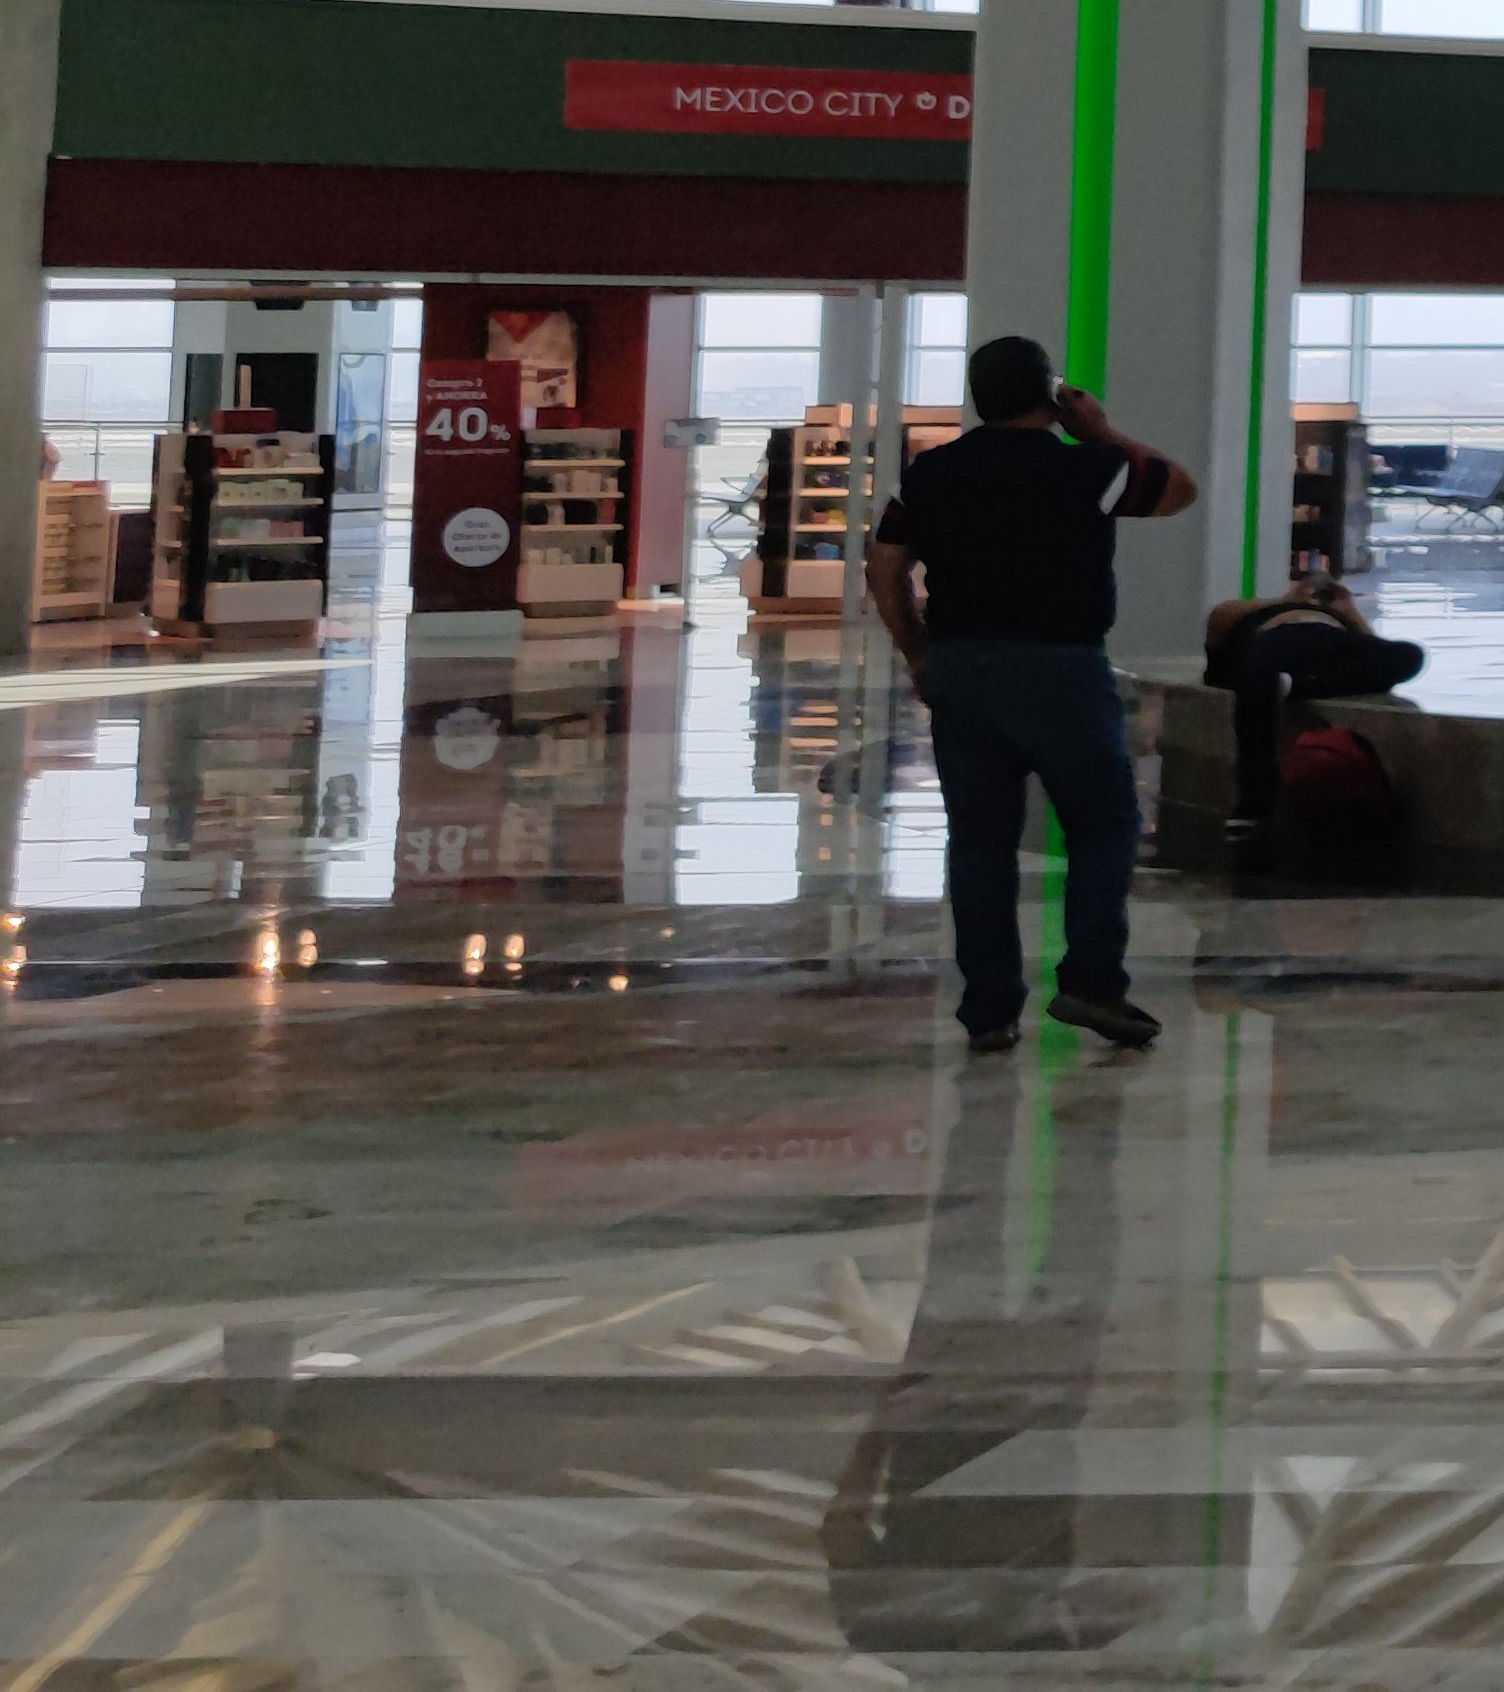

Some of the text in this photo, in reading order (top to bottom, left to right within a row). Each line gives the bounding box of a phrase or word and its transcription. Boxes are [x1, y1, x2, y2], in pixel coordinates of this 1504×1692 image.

[676, 87, 814, 115] MEXICO
[824, 91, 903, 117] CITY
[425, 406, 512, 442] 40%
